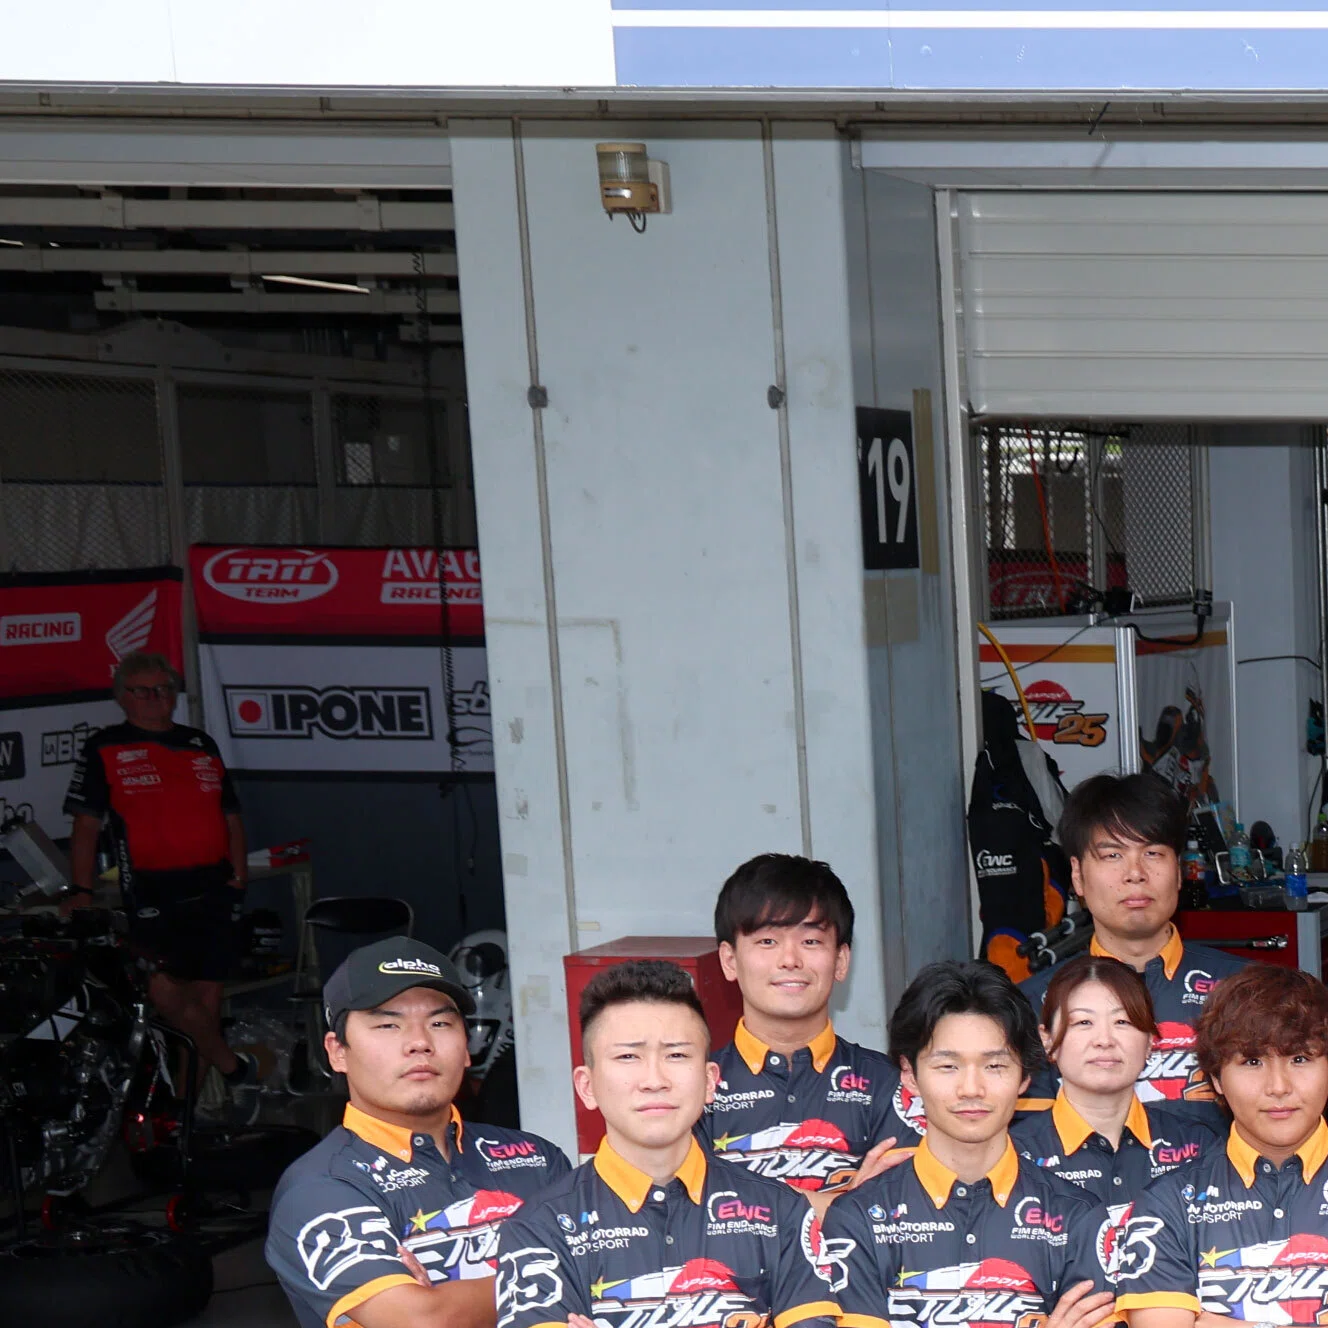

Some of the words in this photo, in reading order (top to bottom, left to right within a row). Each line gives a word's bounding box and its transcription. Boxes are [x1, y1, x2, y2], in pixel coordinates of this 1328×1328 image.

[867, 437, 911, 543] 19
[246, 587, 299, 597] TEAM
[6, 620, 74, 640] RACING
[271, 692, 425, 733] IPONE
[1054, 713, 1109, 746] 25
[384, 957, 441, 972] alpha
[792, 1136, 839, 1145] JPON
[1157, 1143, 1200, 1163] EWC
[718, 1201, 770, 1221] EWC
[300, 1205, 402, 1291] 25
[676, 1278, 732, 1290] JPON
[972, 1276, 1031, 1288] JPON
